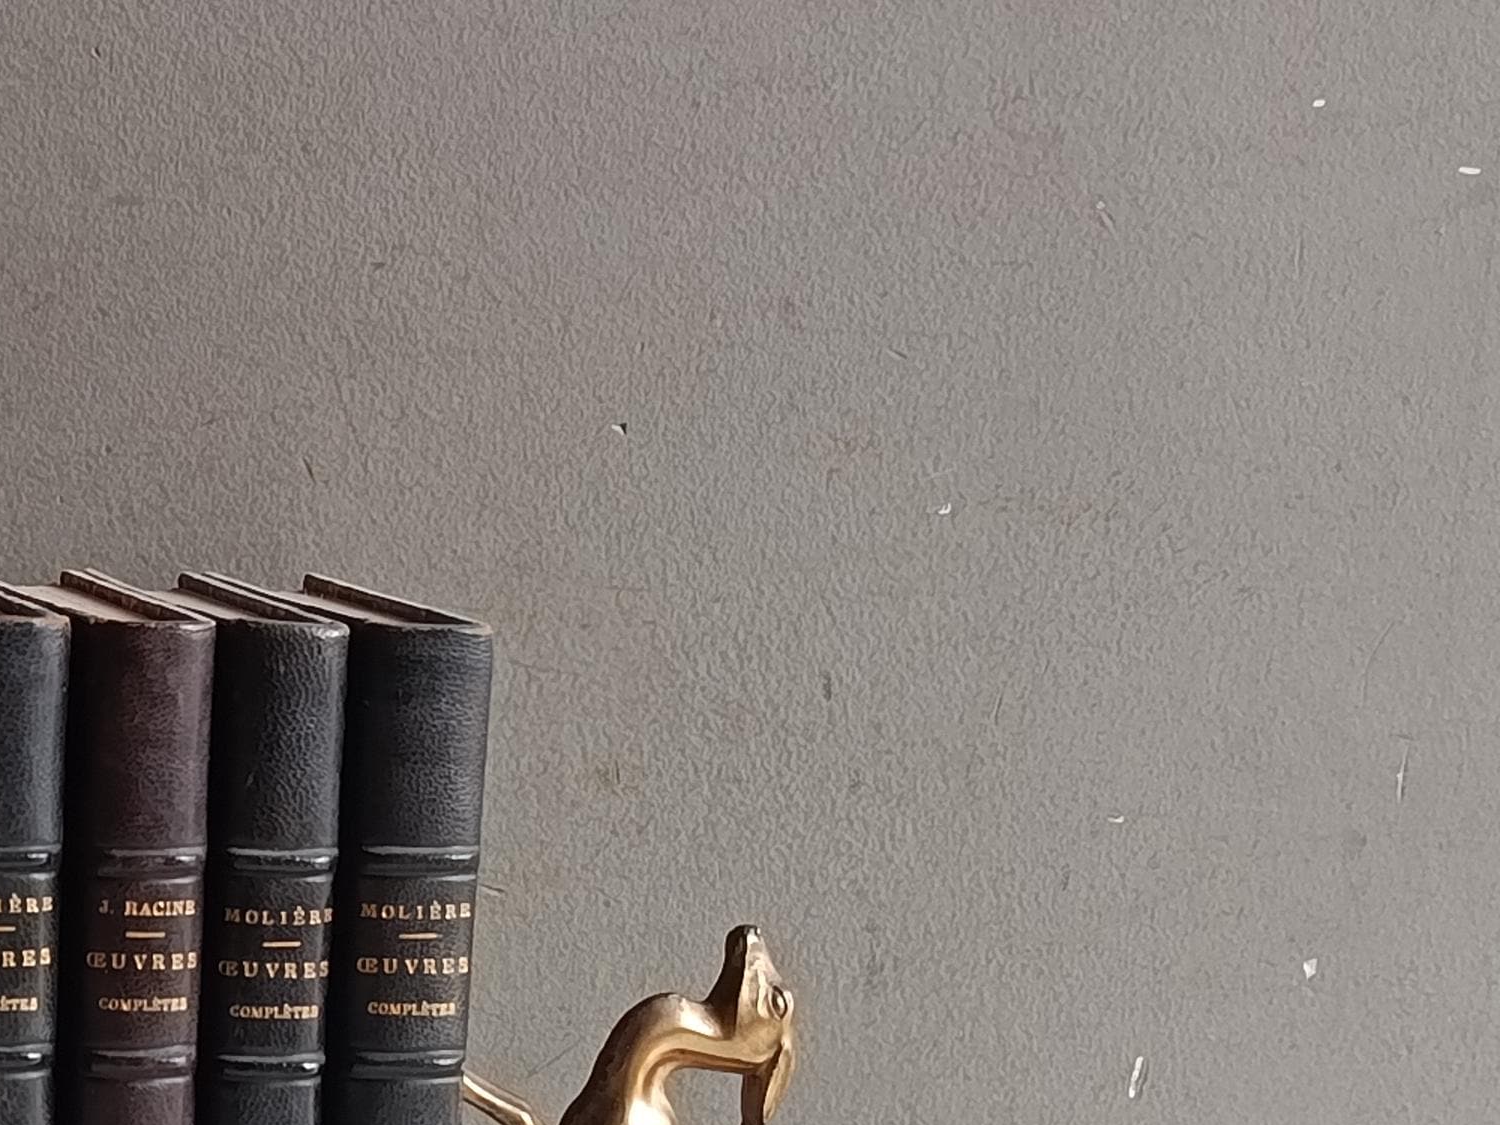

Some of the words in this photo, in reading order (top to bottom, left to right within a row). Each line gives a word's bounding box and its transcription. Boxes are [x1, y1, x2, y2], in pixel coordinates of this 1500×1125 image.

[99, 900, 114, 914] J.
[124, 900, 195, 916] RACINE
[224, 905, 333, 925] MOLIÈRE
[360, 900, 471, 920] MOLIÈRE
[86, 952, 197, 970] ŒUVRES
[218, 960, 329, 979] ŒUVRES
[357, 957, 469, 974] ŒUVRES
